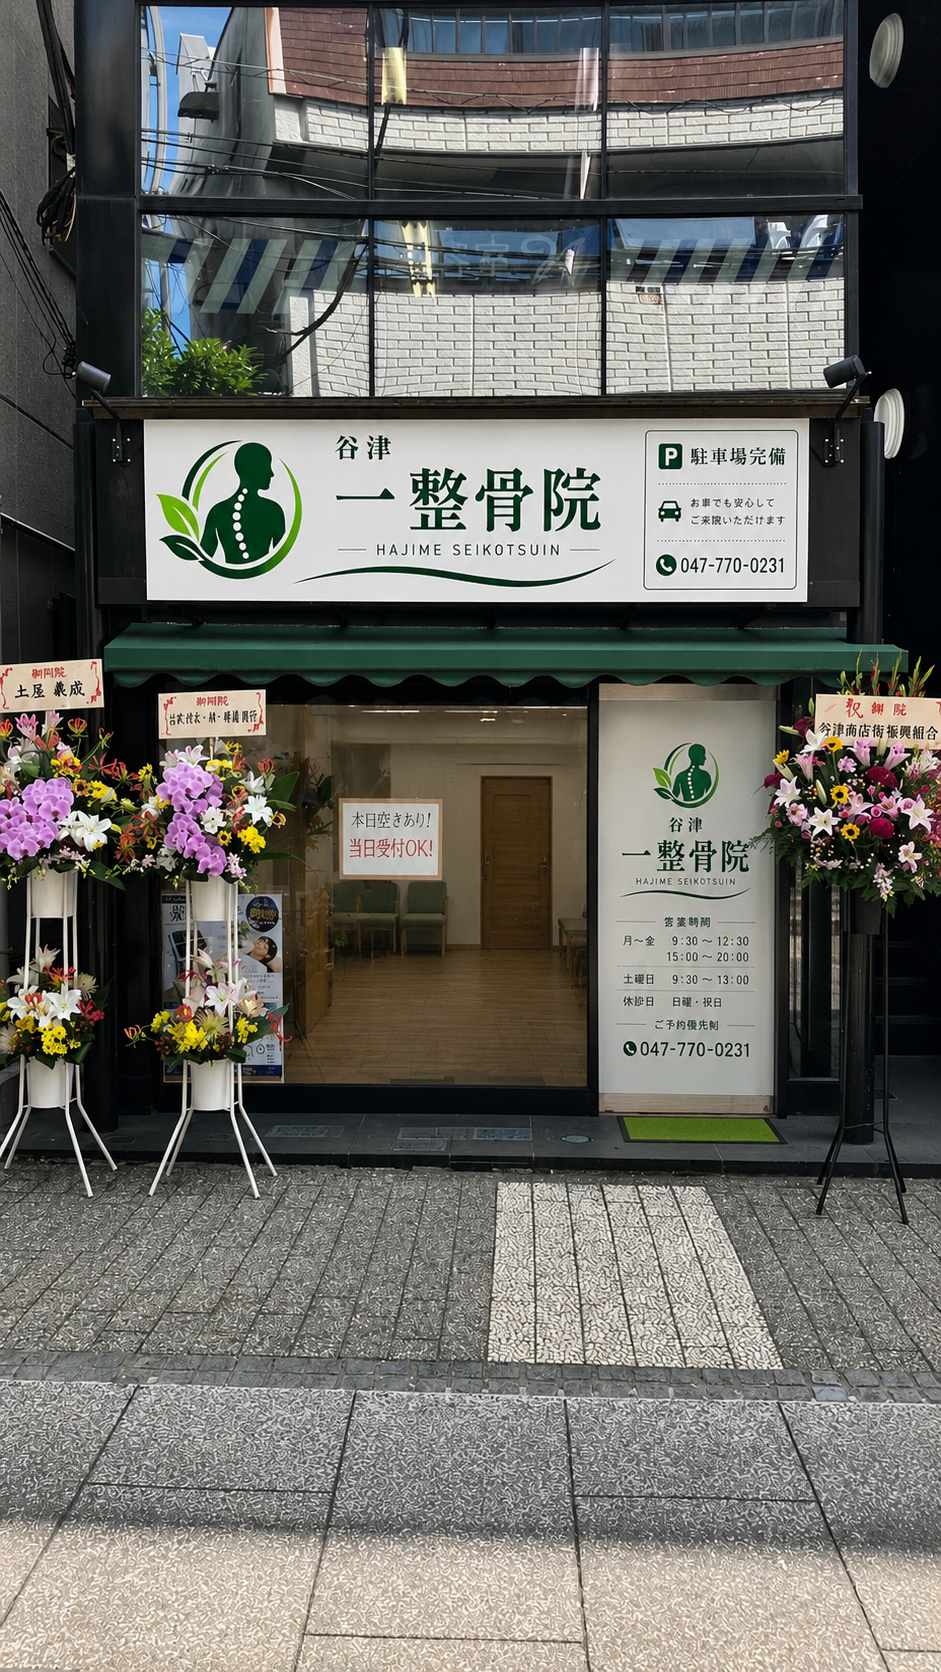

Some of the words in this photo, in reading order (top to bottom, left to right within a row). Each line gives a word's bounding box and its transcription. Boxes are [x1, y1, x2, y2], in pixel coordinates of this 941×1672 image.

[335, 434, 392, 461] 谷津
[690, 446, 786, 466] 駐車場完備
[335, 466, 602, 533] 一整骨院
[690, 497, 775, 509] お車でも安心して
[690, 515, 786, 526] ご来院いただけます
[376, 543, 442, 556] HAJIME
[452, 543, 560, 557] SEIKOTSUIN
[680, 557, 784, 574] 047-770-0231
[668, 816, 703, 833] 谷津
[349, 838, 433, 858] 当日受付OK!
[621, 839, 750, 873] 一整骨院
[635, 877, 673, 886] HAJIME
[677, 877, 736, 887] SEIKOTSUIN
[671, 935, 699, 947] 9:30
[717, 935, 750, 947] 12:30
[666, 951, 699, 963] 15:00
[716, 951, 750, 963] 20:00
[623, 973, 654, 985] 土曜日
[672, 974, 699, 985] 9:30
[717, 974, 750, 986] 13:00
[640, 1041, 750, 1058] 047-770-0231
